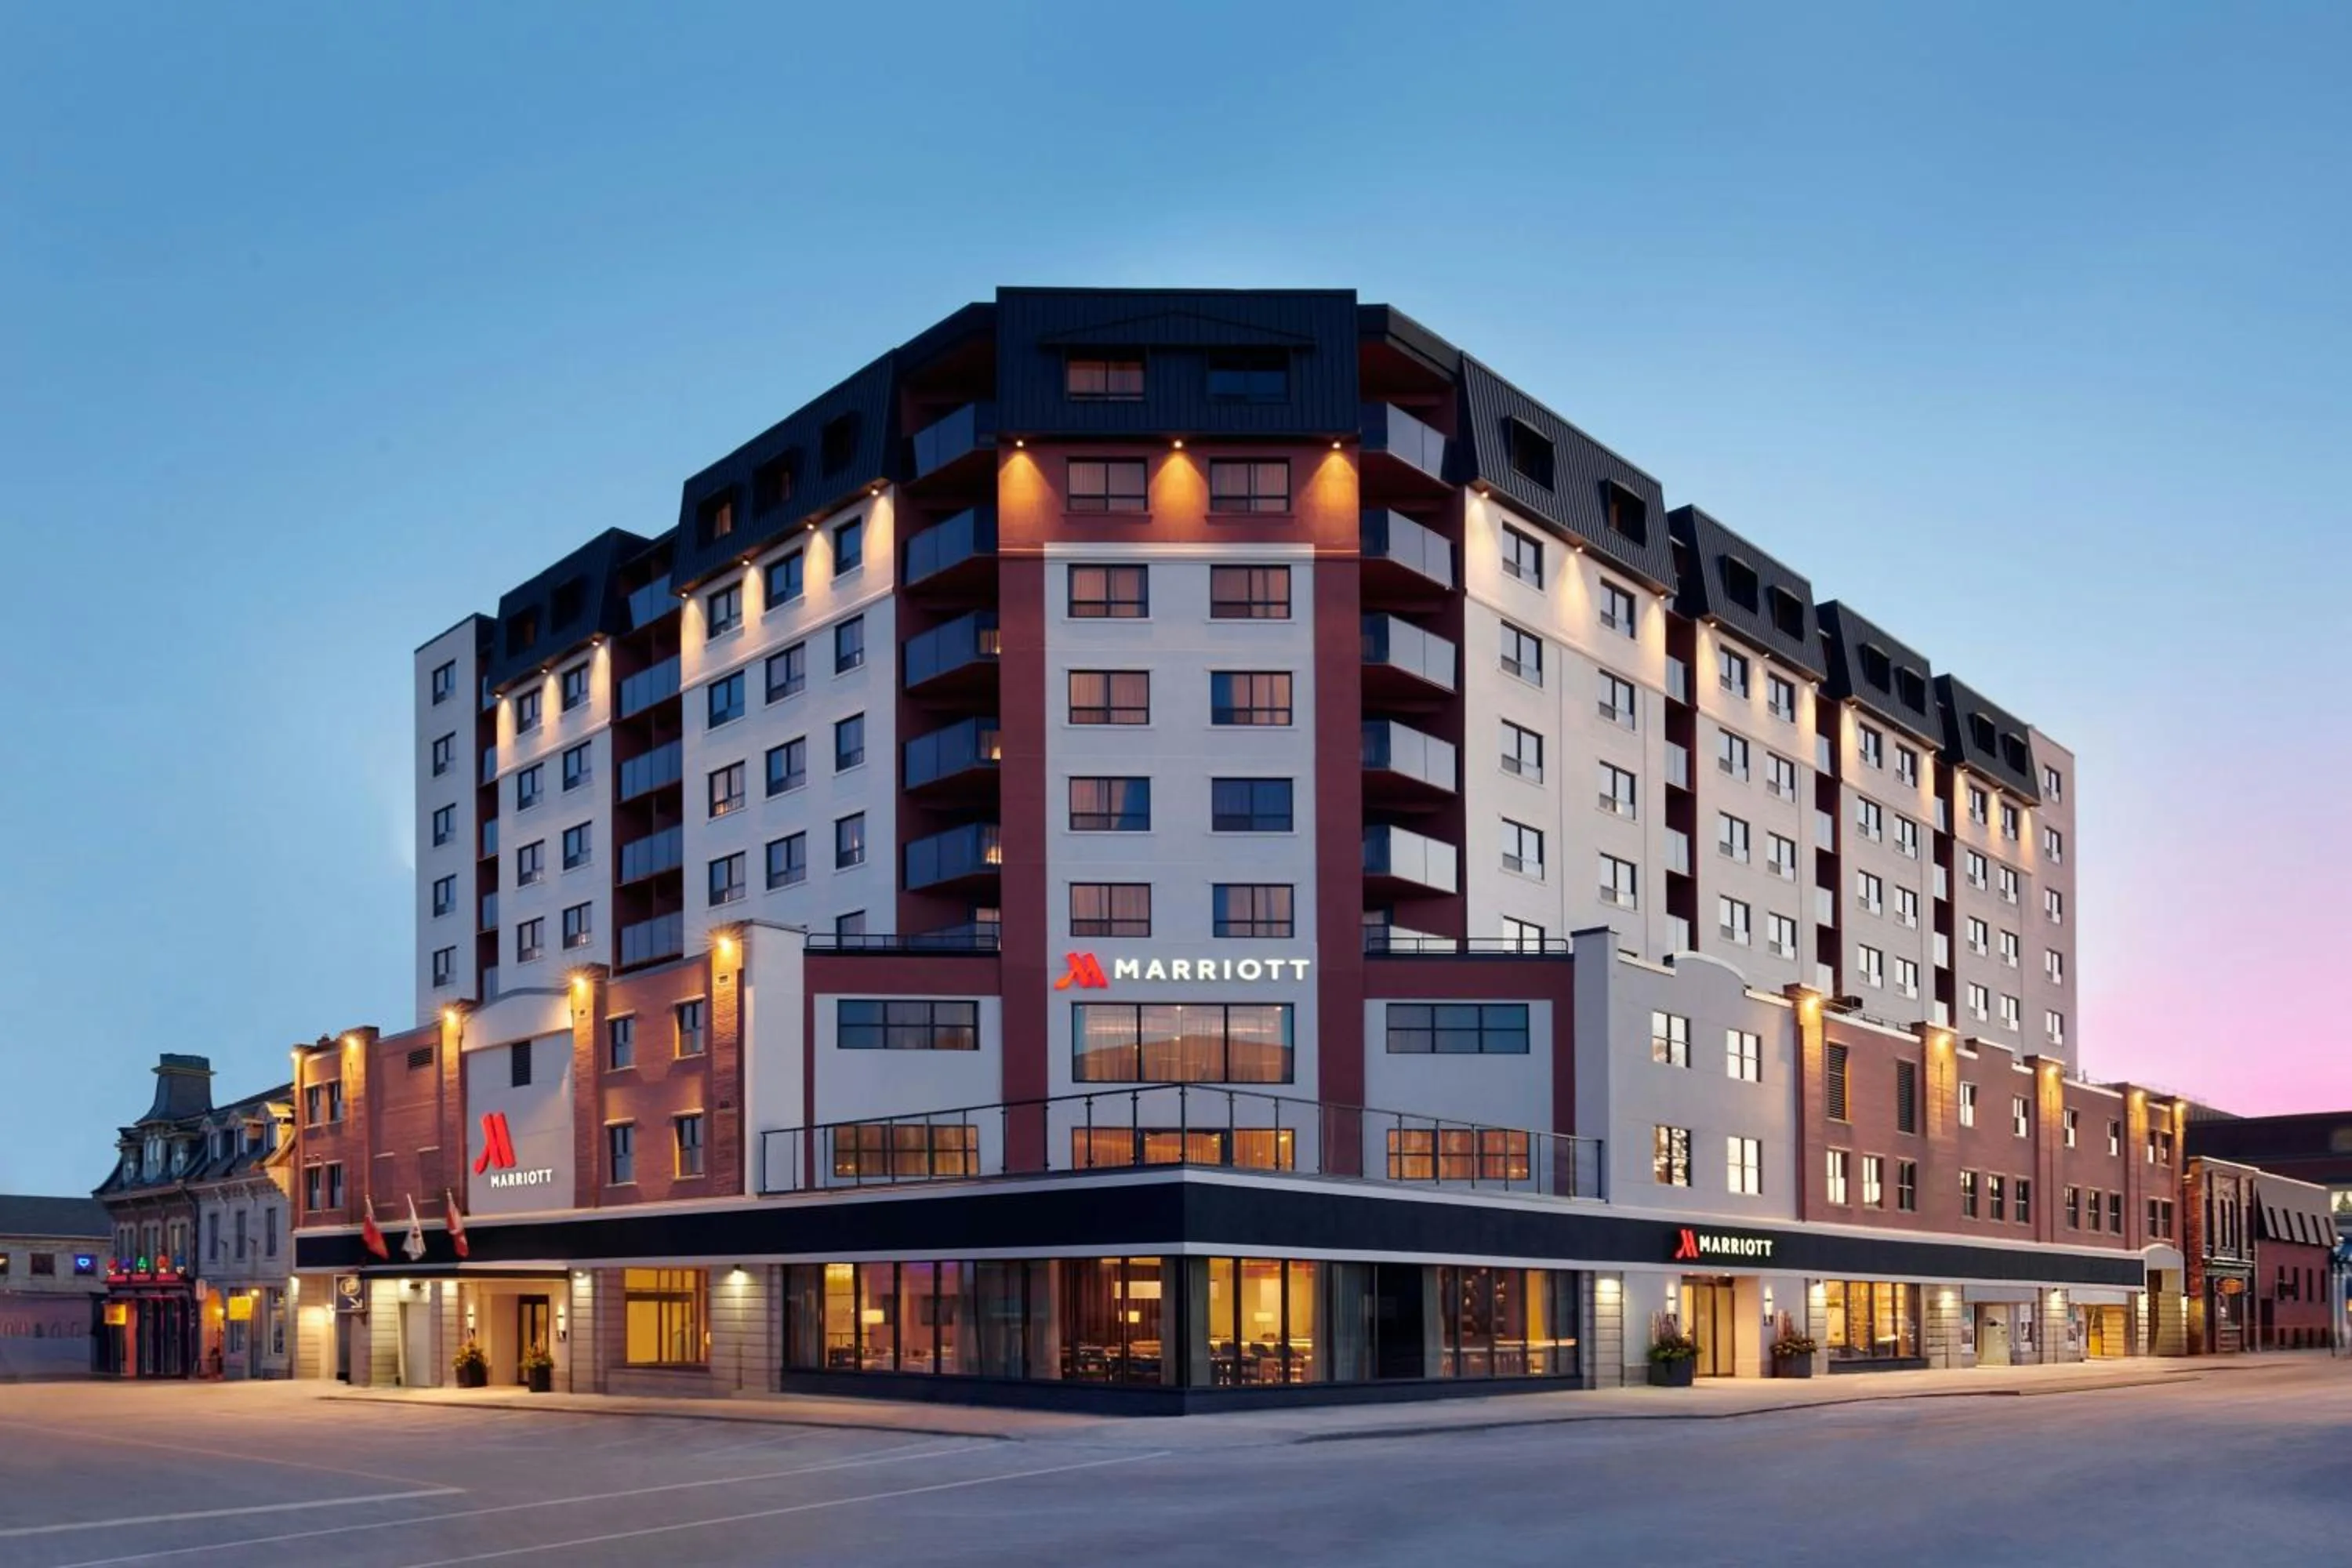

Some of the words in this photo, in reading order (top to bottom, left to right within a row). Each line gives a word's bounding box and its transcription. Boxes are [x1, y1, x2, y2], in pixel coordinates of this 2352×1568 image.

[1114, 959, 1310, 980] MARRIOTT
[490, 1168, 553, 1188] MARRIOTT
[1699, 1235, 1772, 1257] MARRIOTT
